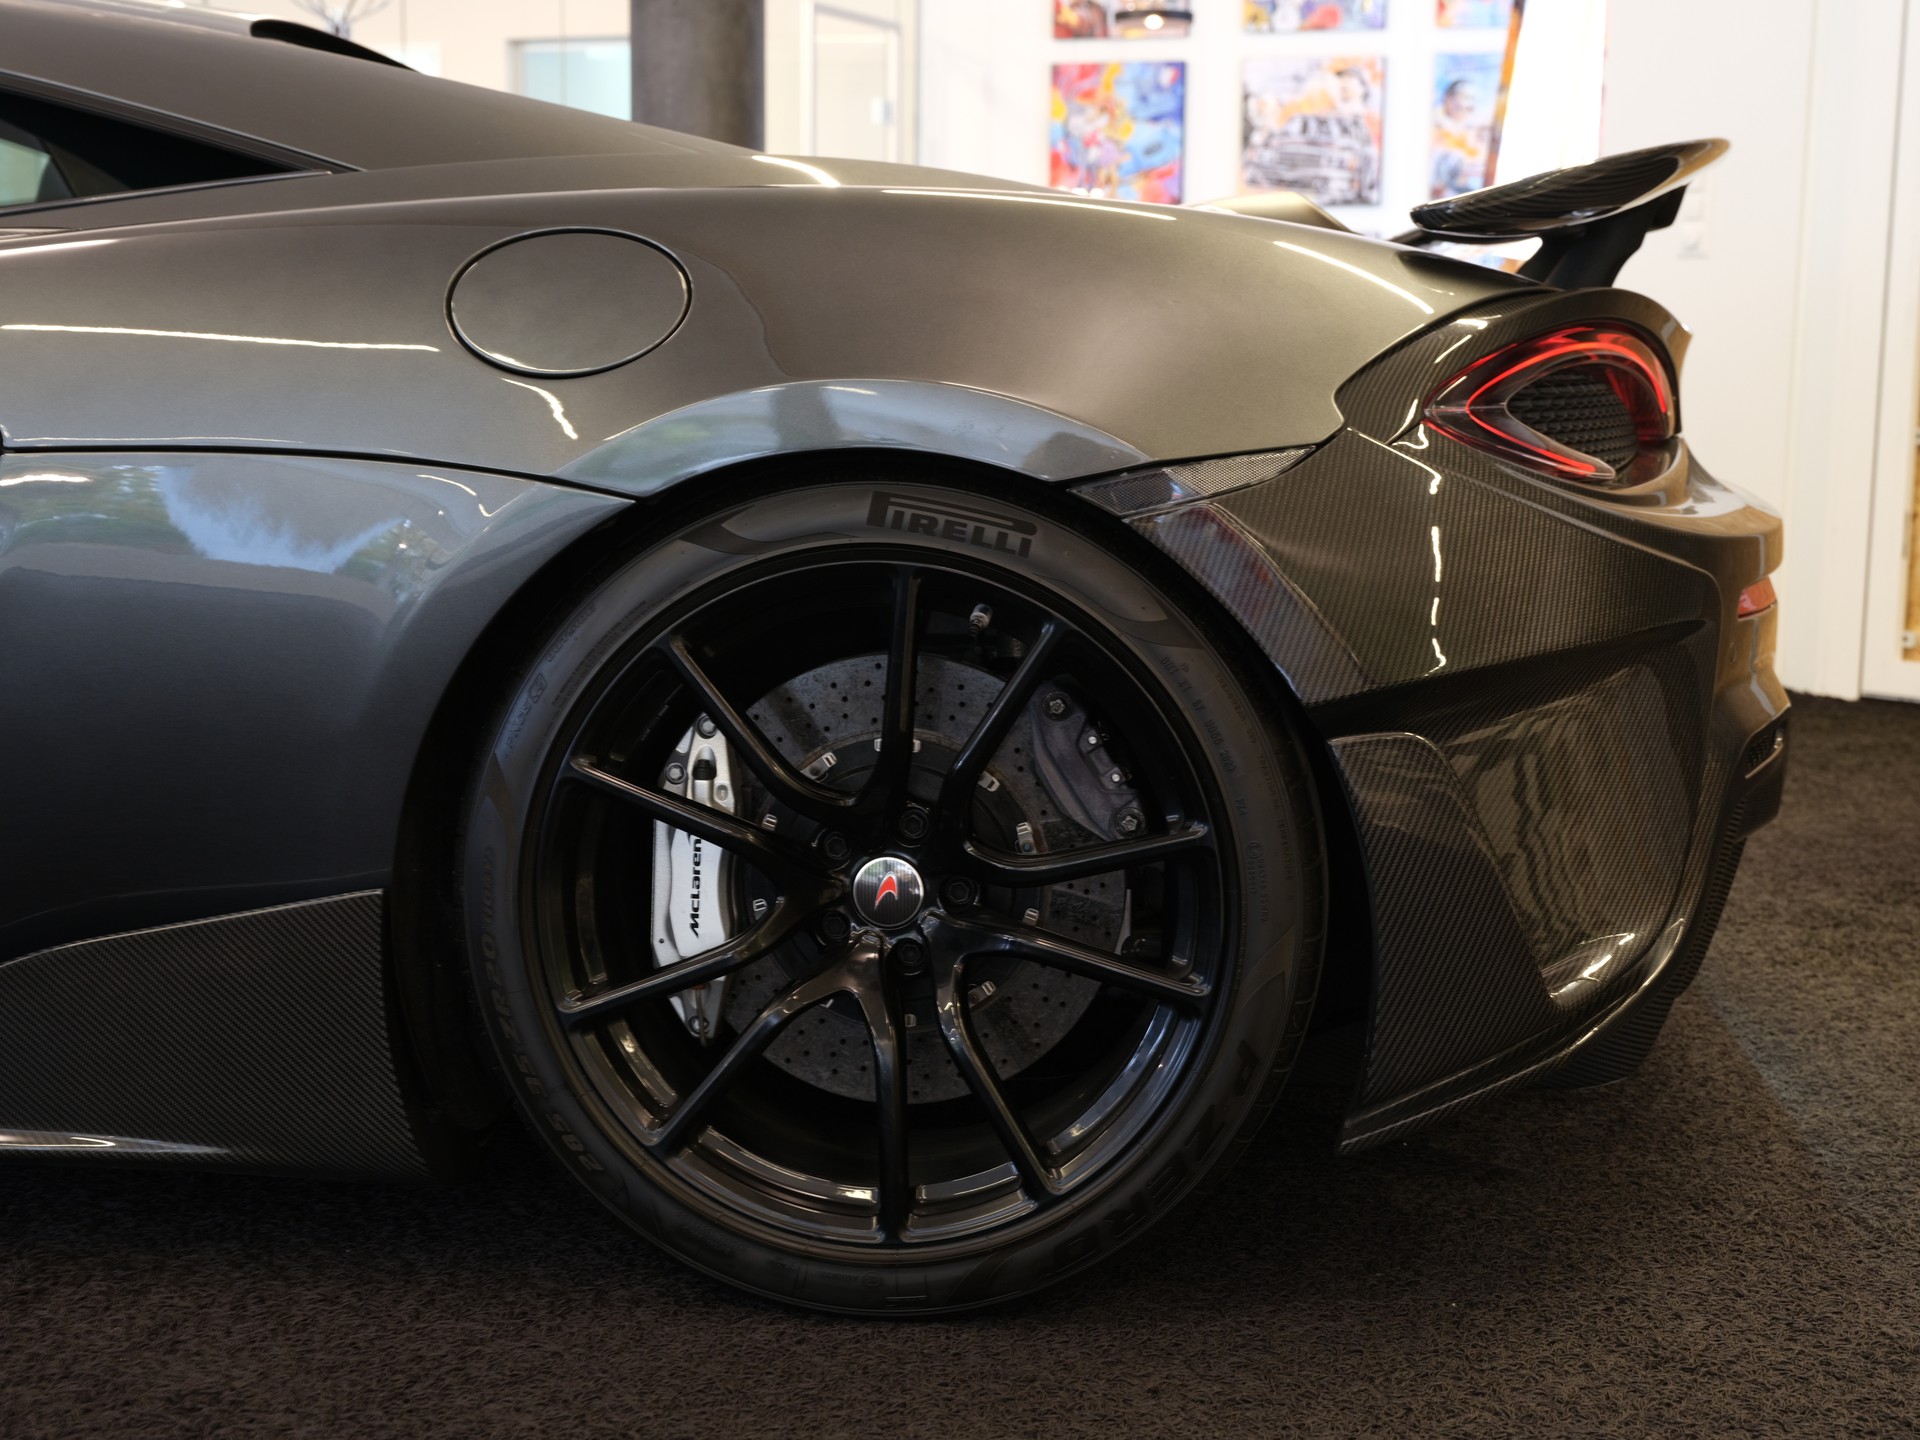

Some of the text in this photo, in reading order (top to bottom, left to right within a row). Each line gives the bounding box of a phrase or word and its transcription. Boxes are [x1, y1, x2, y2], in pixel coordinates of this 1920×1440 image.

[866, 490, 1037, 558] PIRELLI
[689, 838, 702, 938] McLaren
[548, 1111, 605, 1172] 285
[1048, 1040, 1262, 1272] P ZERO
